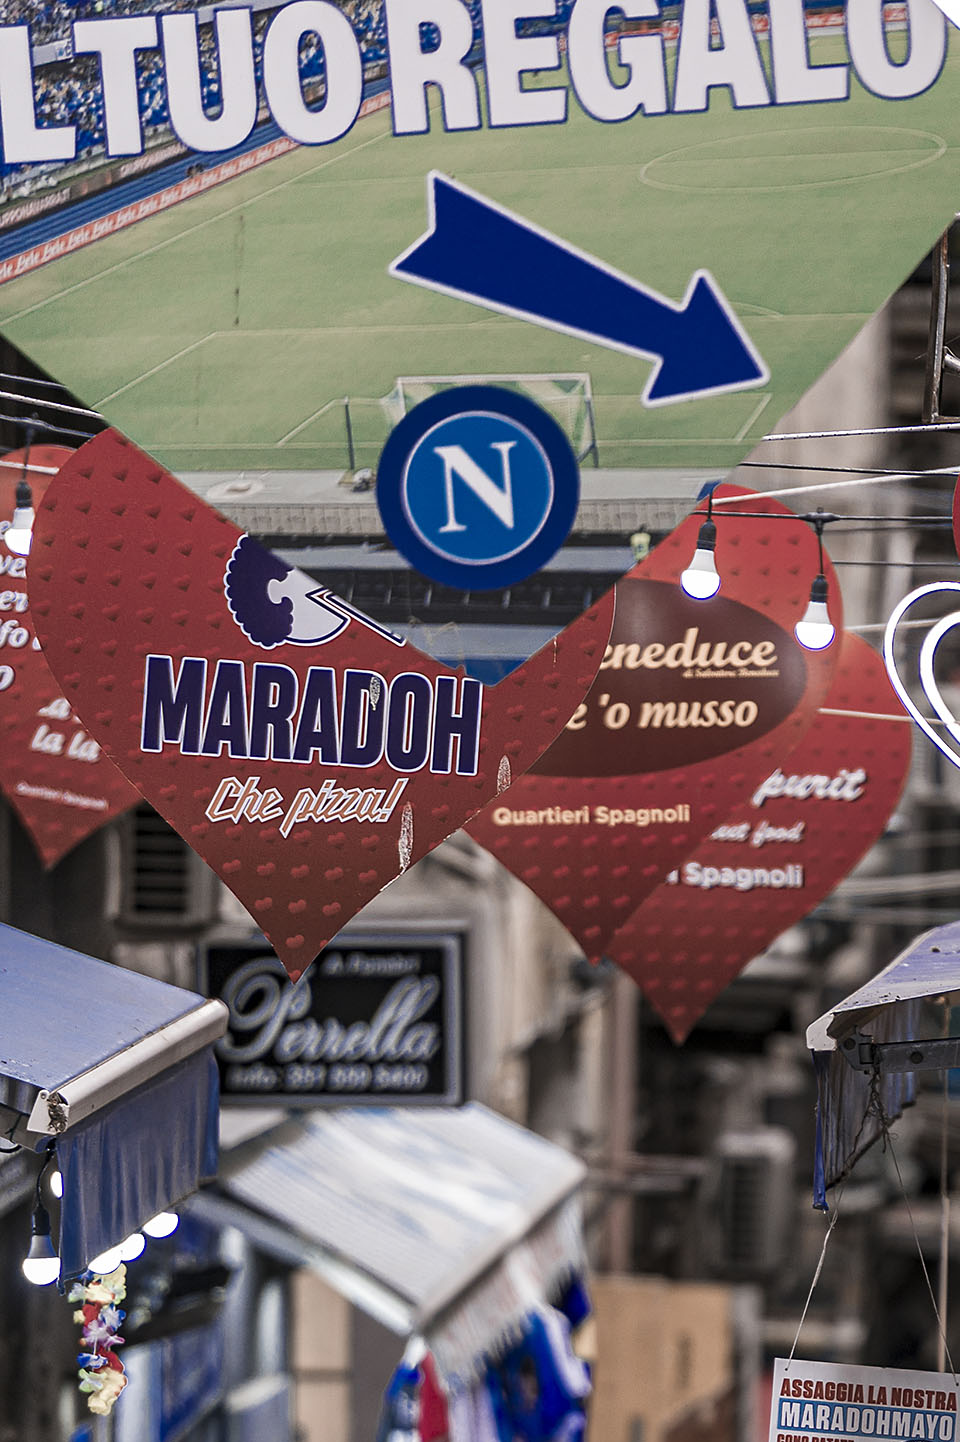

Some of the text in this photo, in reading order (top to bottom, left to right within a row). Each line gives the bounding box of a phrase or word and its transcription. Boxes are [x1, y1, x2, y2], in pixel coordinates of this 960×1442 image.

[391, 0, 950, 135] REGALO
[432, 440, 523, 534] N
[600, 625, 778, 671] eneduce
[140, 653, 484, 777] MARADOH
[638, 699, 760, 730] musso
[205, 775, 411, 839] Che pizza!
[492, 804, 692, 827] Quartieri Spagnoli
[684, 862, 804, 891] Spagnoli
[780, 1378, 958, 1412] ASSAGGIA LA NOSTRA
[780, 1400, 954, 1441] MARADOHMAYO
